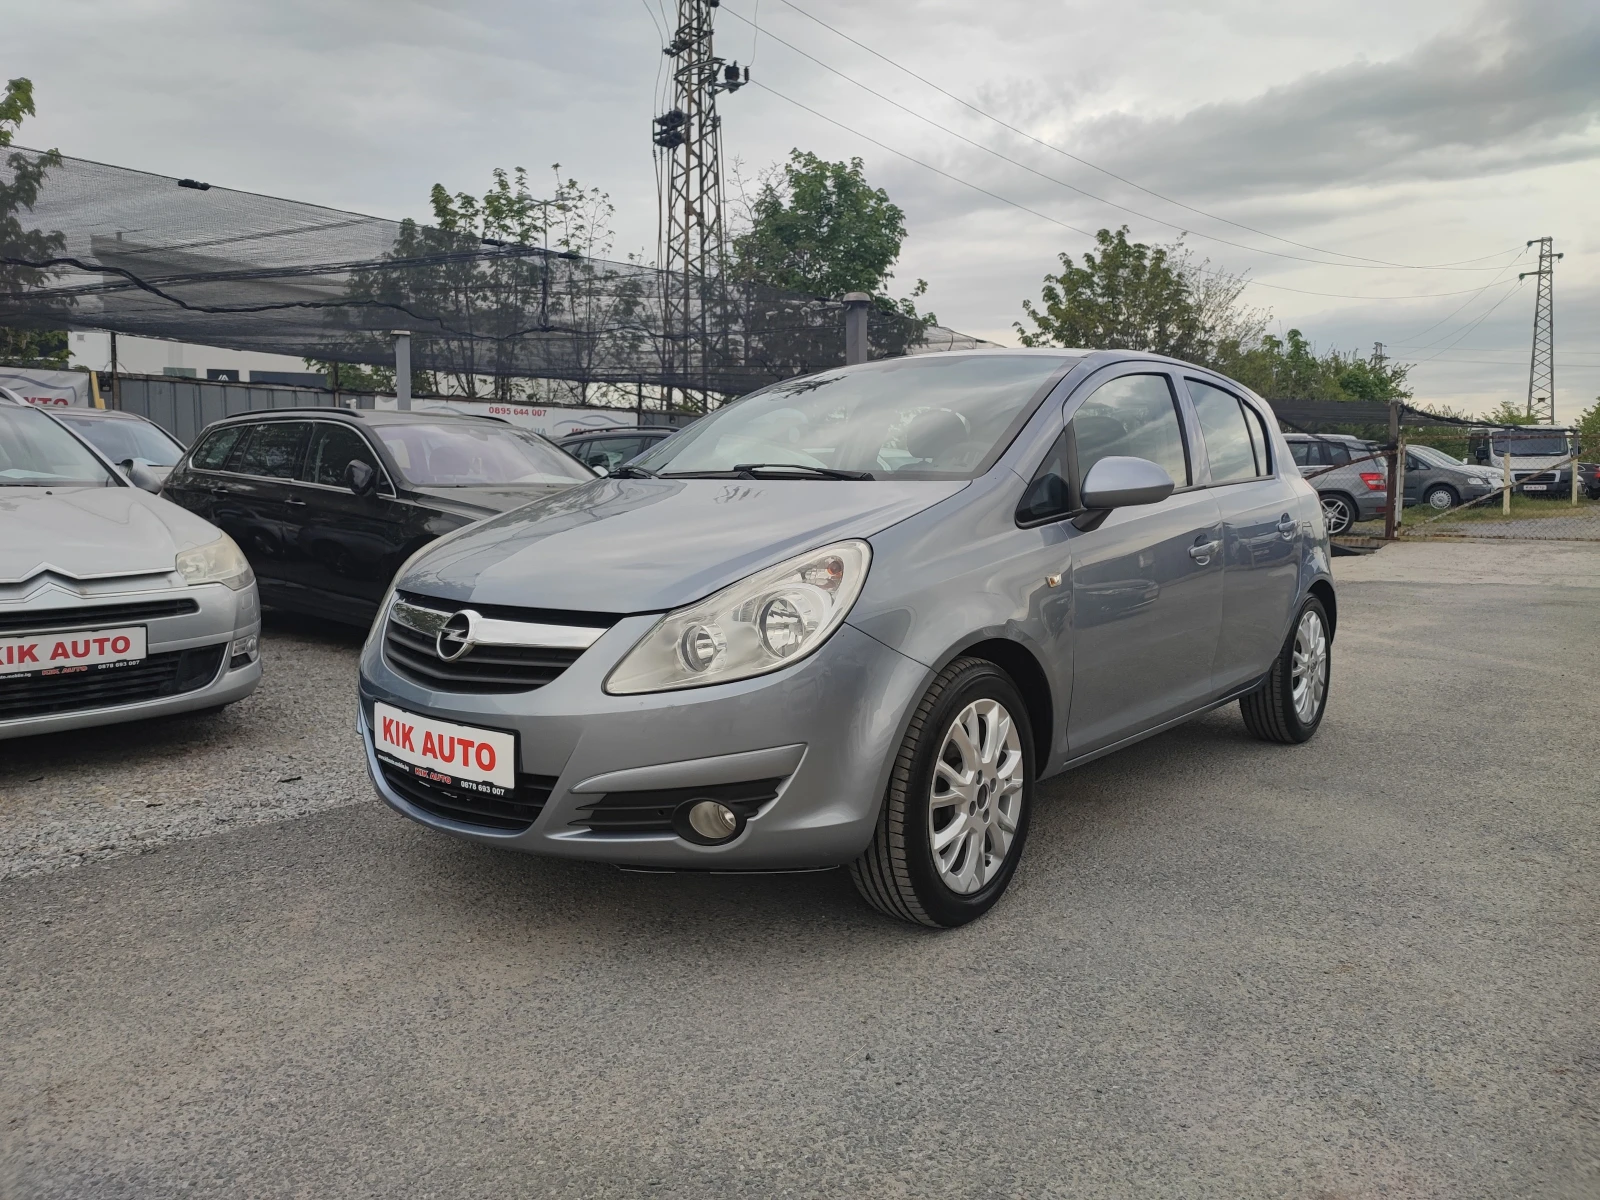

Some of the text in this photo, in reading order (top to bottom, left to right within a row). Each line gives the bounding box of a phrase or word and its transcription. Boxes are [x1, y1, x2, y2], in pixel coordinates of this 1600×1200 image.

[488, 406, 547, 417] 0895 644 007
[0, 635, 131, 666] IK AUTO
[382, 715, 496, 772] KIK AUTO
[460, 780, 477, 791] 0878
[492, 787, 505, 796] 007
